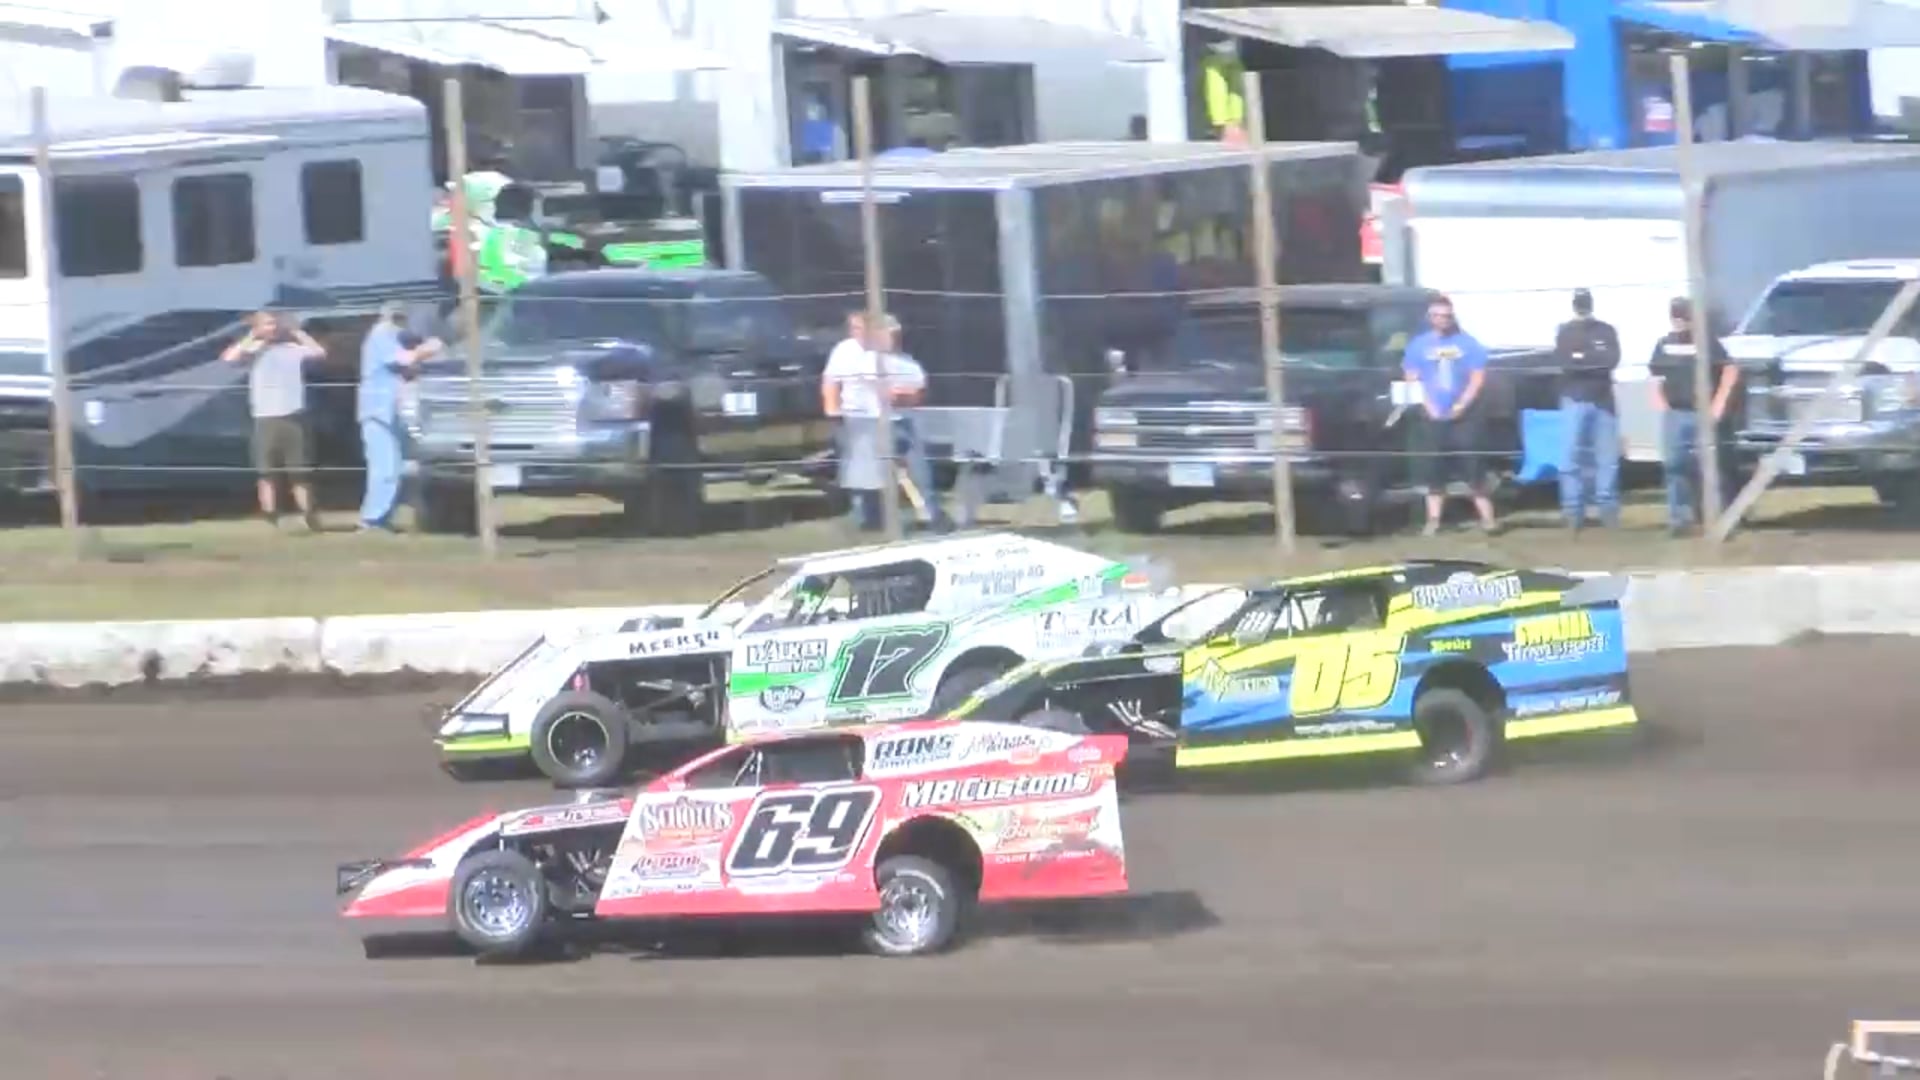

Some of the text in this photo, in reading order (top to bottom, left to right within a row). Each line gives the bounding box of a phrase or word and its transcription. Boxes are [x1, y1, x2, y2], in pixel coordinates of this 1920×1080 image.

[829, 621, 950, 706] 17
[1290, 632, 1406, 717] 05
[728, 788, 880, 873] 69
